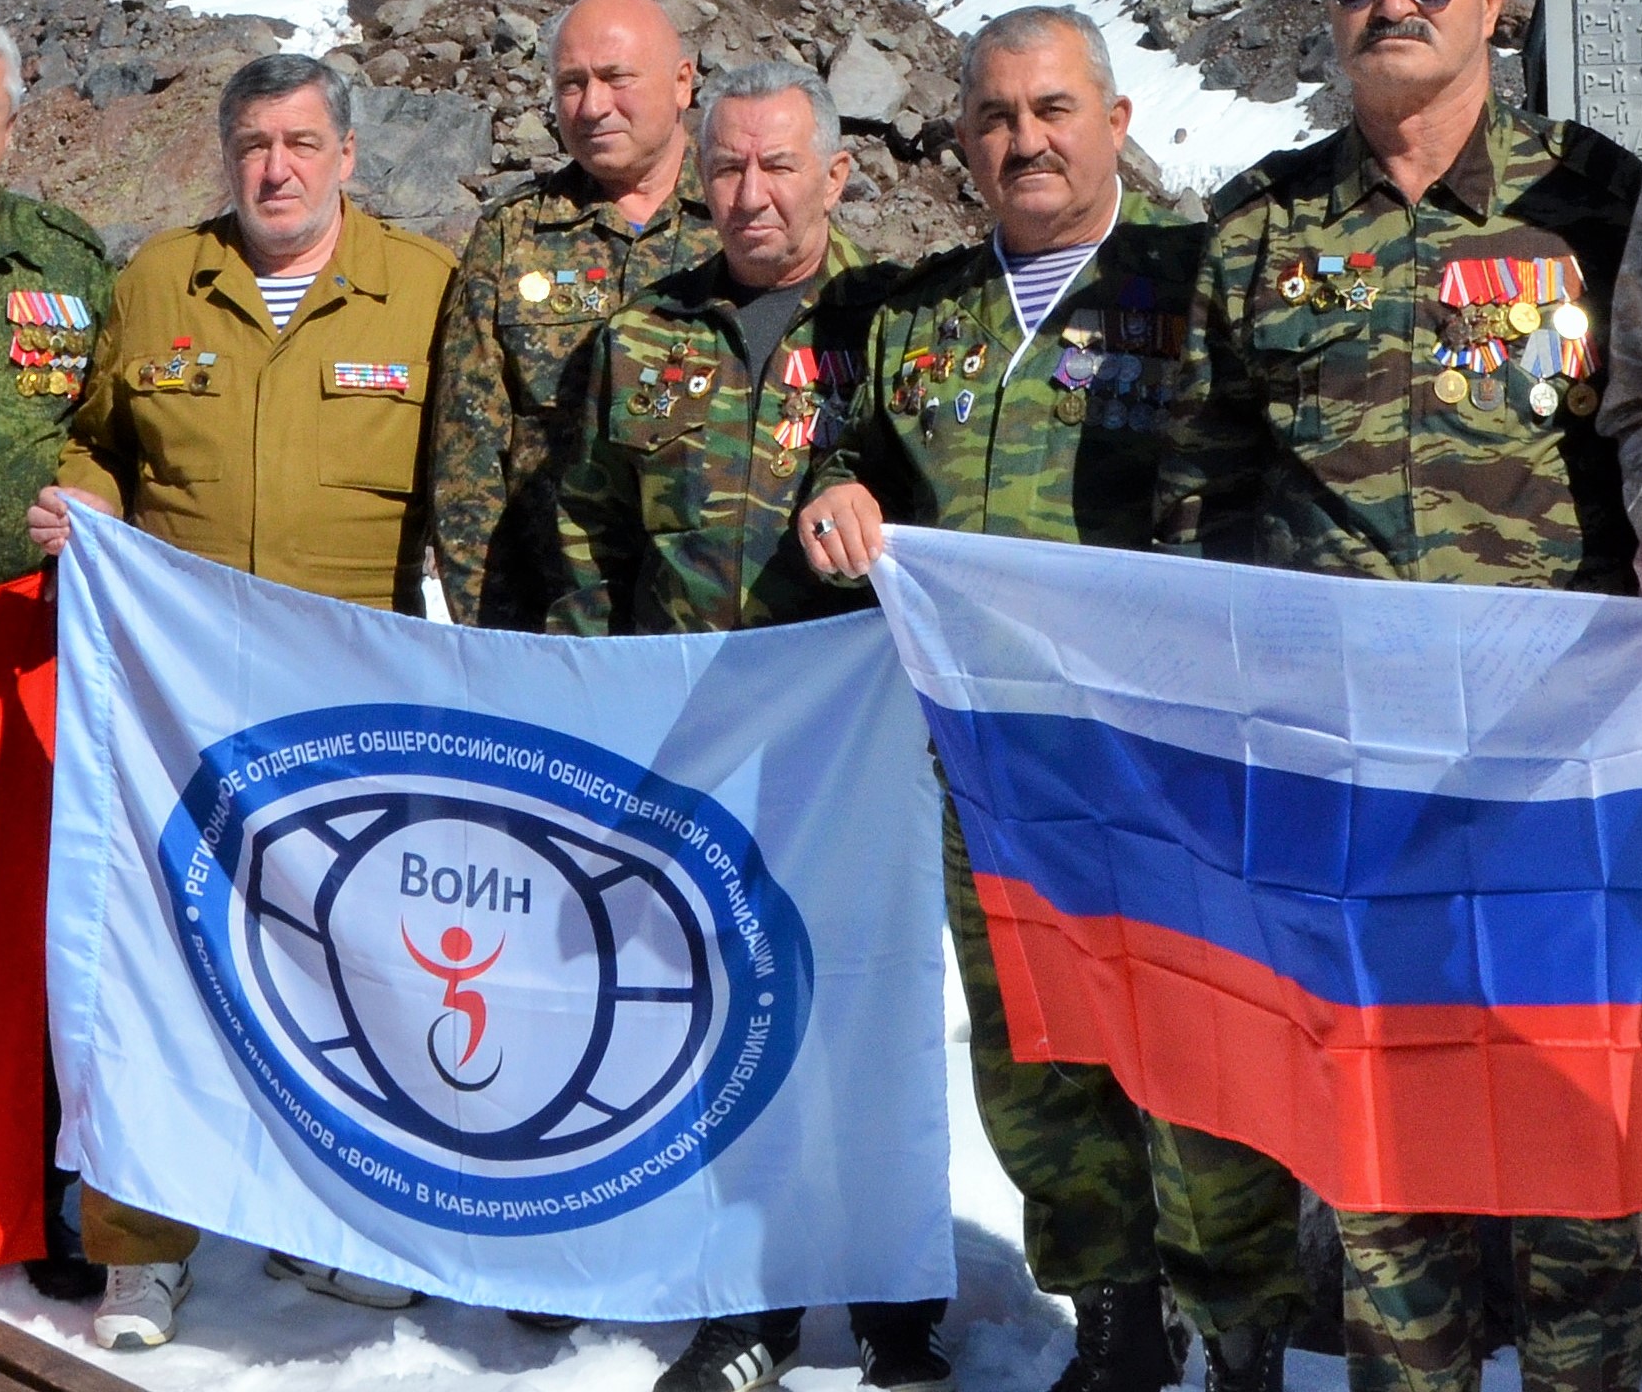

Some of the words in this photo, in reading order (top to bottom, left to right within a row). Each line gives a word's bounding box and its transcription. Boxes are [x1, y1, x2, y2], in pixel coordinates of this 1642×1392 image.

[245, 733, 355, 782] ОТДЕЛЕНИЕ
[359, 729, 545, 775] ОБЩЕРОССИЙСКОЙ
[548, 758, 709, 851] ОБЩЕСТВЕННОЙ
[704, 843, 775, 979] ОРГАНИЗАЦИИ
[191, 934, 246, 1035] ВОЕННЫХ
[244, 1036, 335, 1150] ИНВАЛИДОВ
[337, 1145, 411, 1196] «ВОИН»
[416, 1182, 430, 1204] В
[435, 1133, 700, 1222] КАБАРДИНО-БАЛКАРСКОЙ
[691, 1013, 773, 1138] РЕСПУБЛИКЕ
